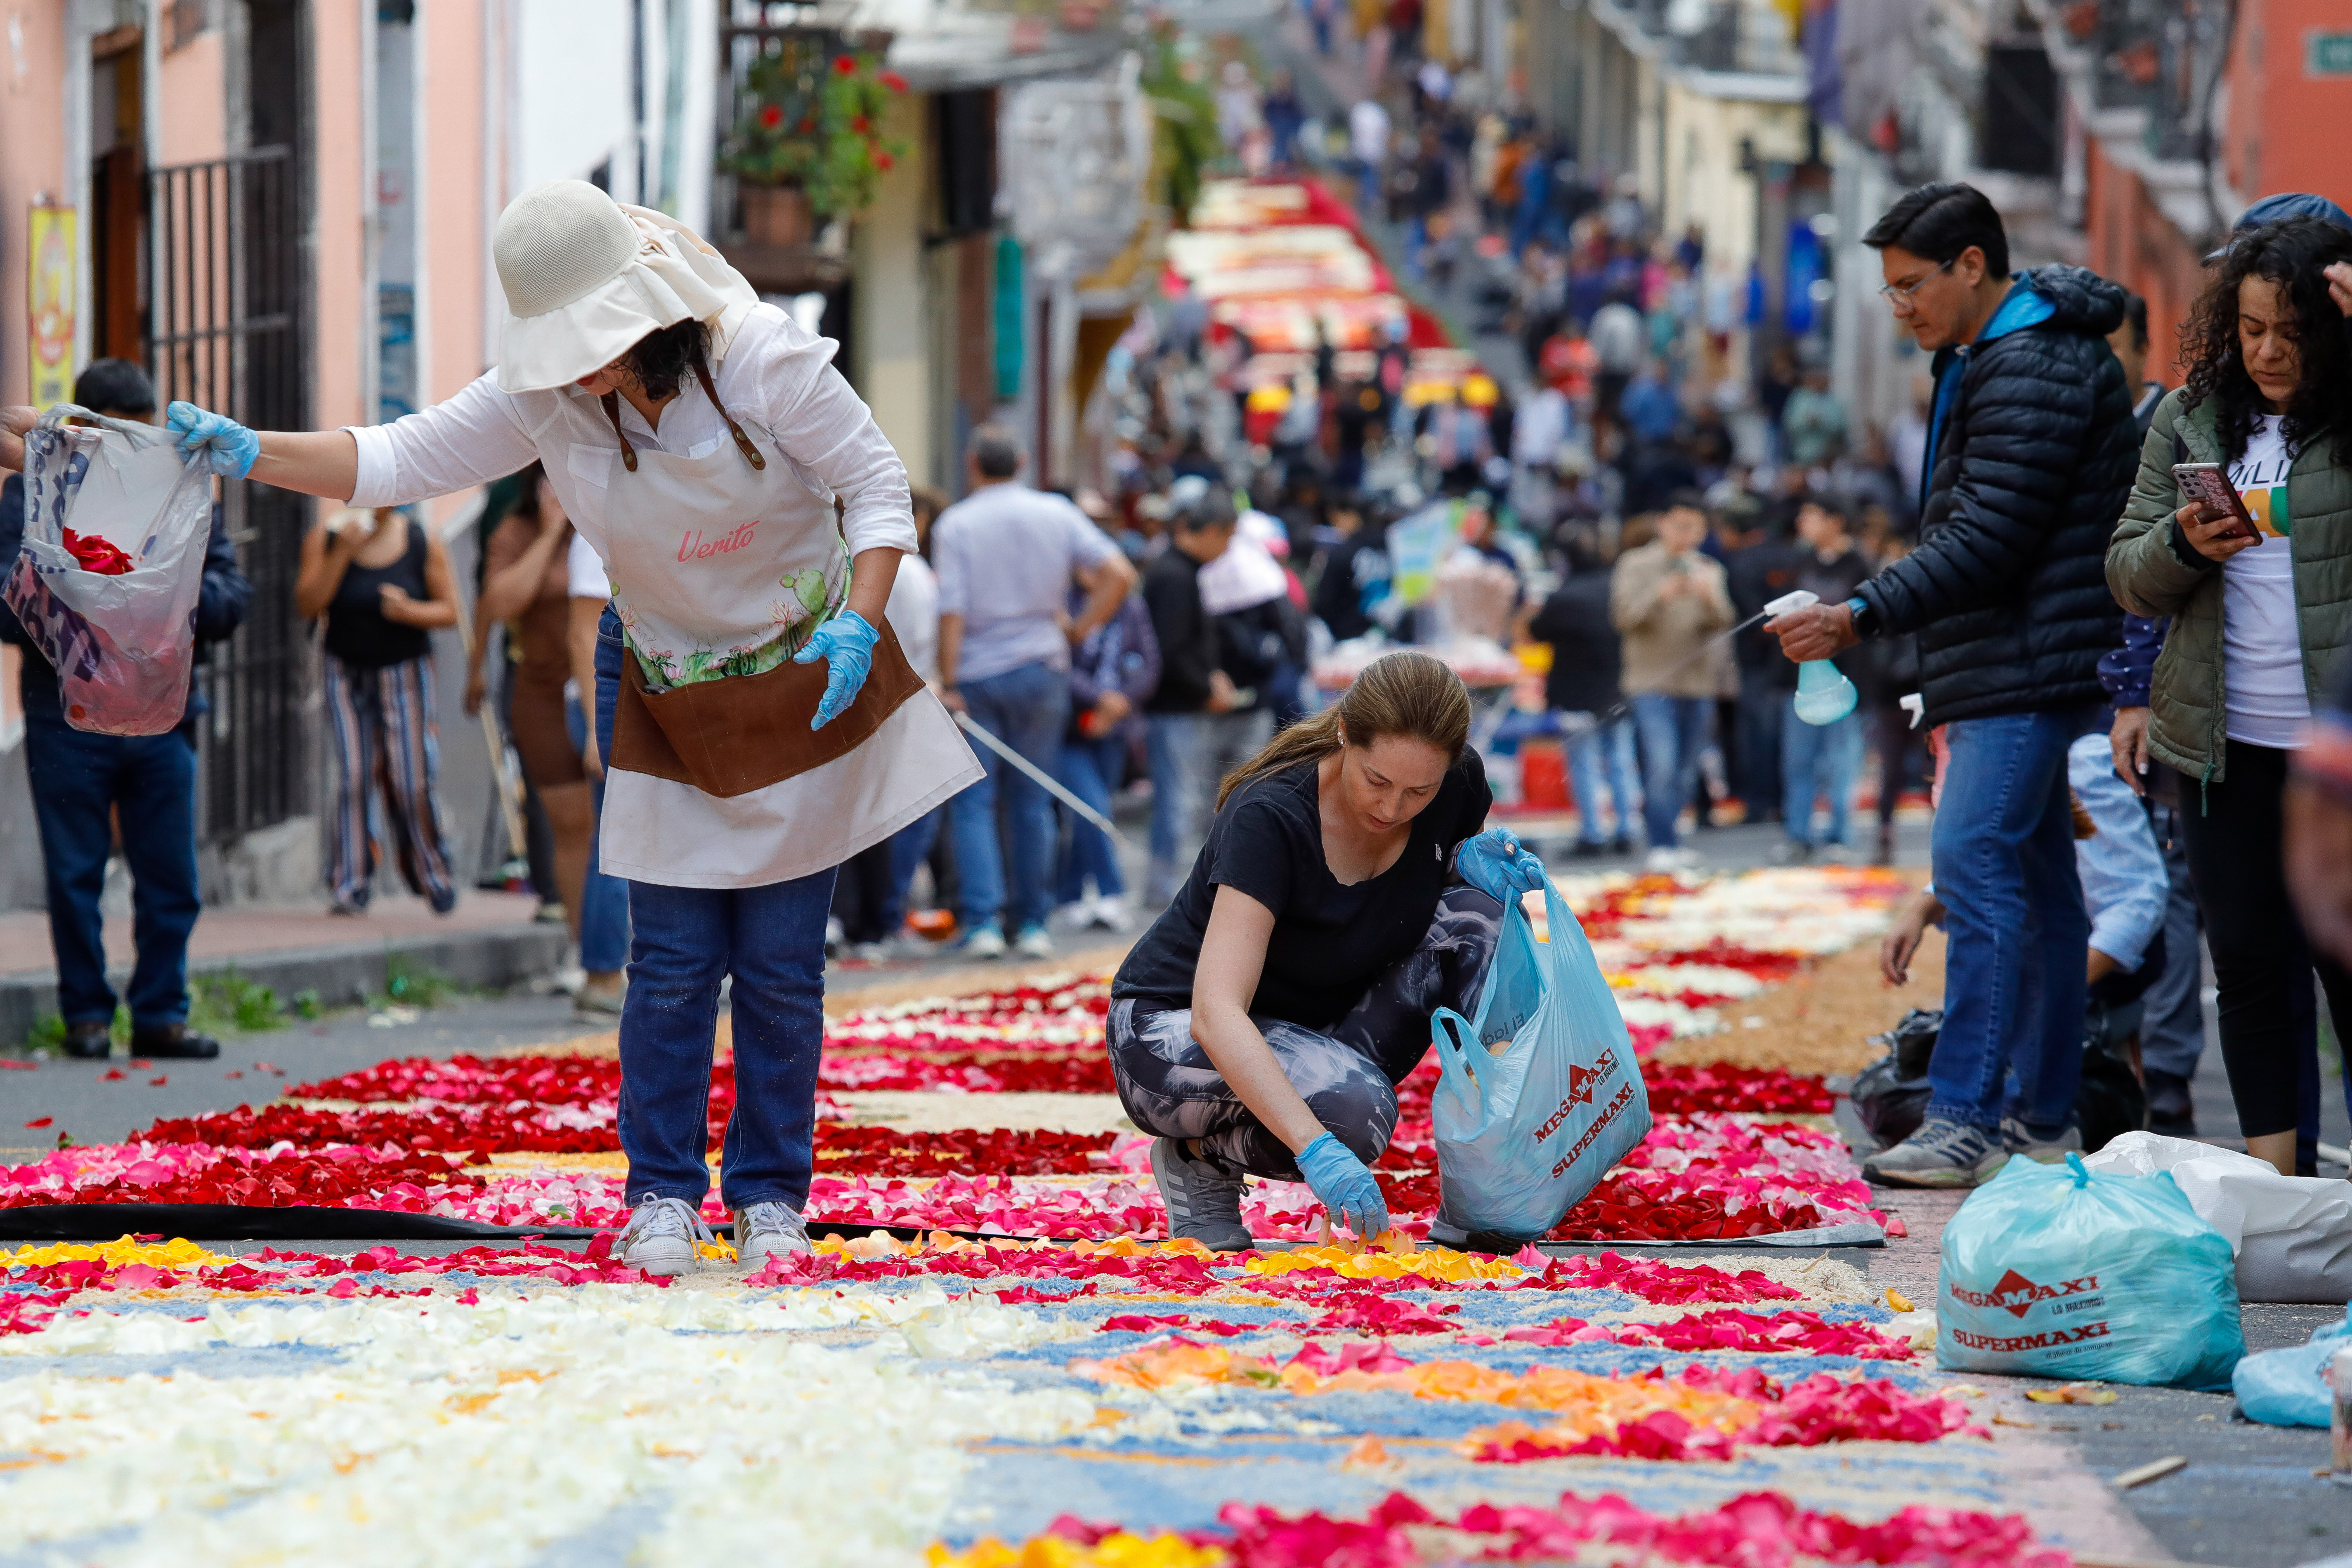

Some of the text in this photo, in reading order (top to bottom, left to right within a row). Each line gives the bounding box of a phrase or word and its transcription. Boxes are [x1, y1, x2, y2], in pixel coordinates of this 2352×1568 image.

[678, 520, 760, 562] Verito
[1533, 1046, 1615, 1145] MEGAMAXI
[1597, 1075, 1605, 1086] LO
[1552, 1081, 1634, 1178] SUPERMAXI
[1953, 1322, 2111, 1352] SUPERMAXI
